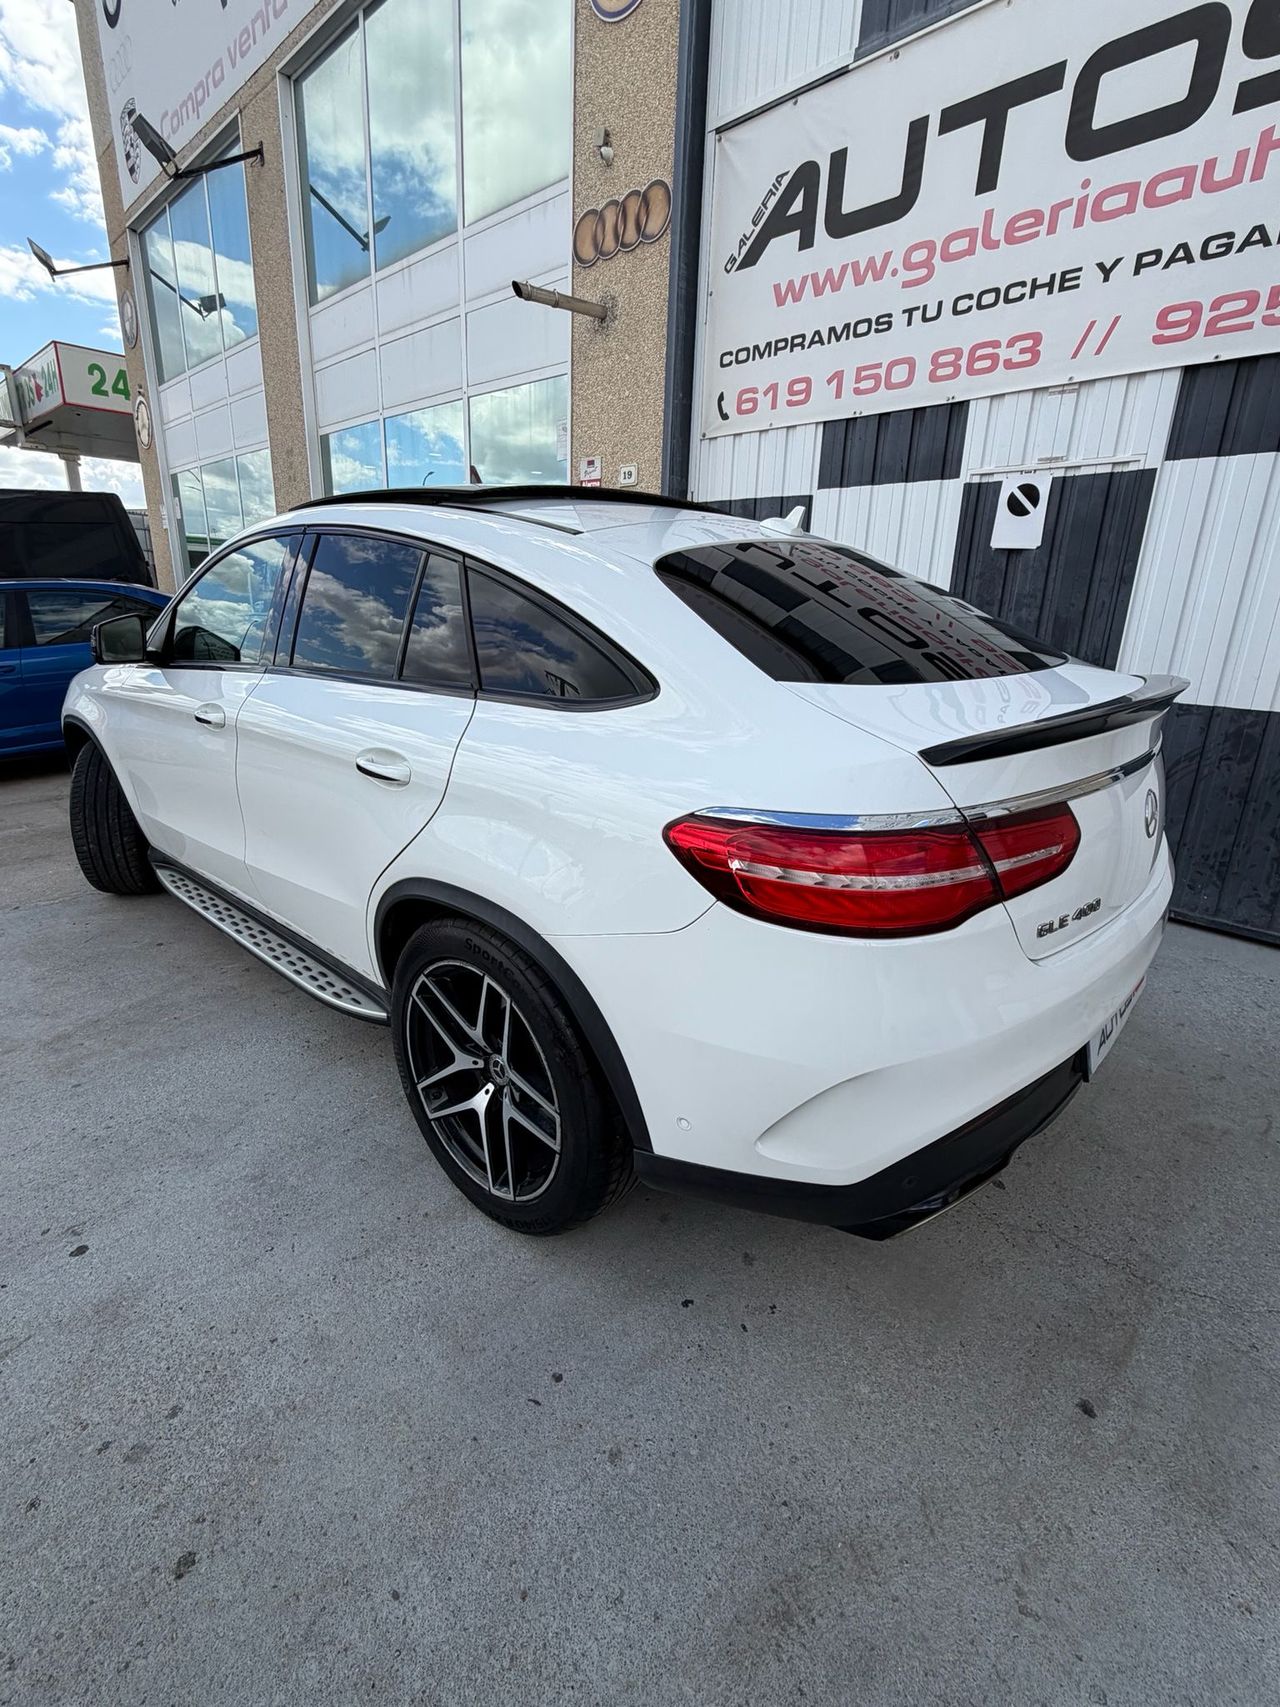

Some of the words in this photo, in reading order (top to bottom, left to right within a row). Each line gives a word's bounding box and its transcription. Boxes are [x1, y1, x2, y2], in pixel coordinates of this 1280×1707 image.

[159, 57, 226, 141] Compra
[734, 0, 1280, 273] AUTO
[723, 169, 791, 274] GALERIA
[719, 313, 893, 368] COMPRAMOS
[901, 300, 943, 327] TU
[951, 266, 1083, 316] COCHE
[1095, 256, 1125, 283] Y
[1132, 223, 1280, 276] PAGA
[87, 362, 131, 401] 24
[735, 376, 813, 416] 619
[826, 356, 916, 400] 150
[928, 331, 1043, 383] 863
[622, 470, 633, 480] 19
[1036, 914, 1070, 938] GLE
[1071, 898, 1102, 921] 400
